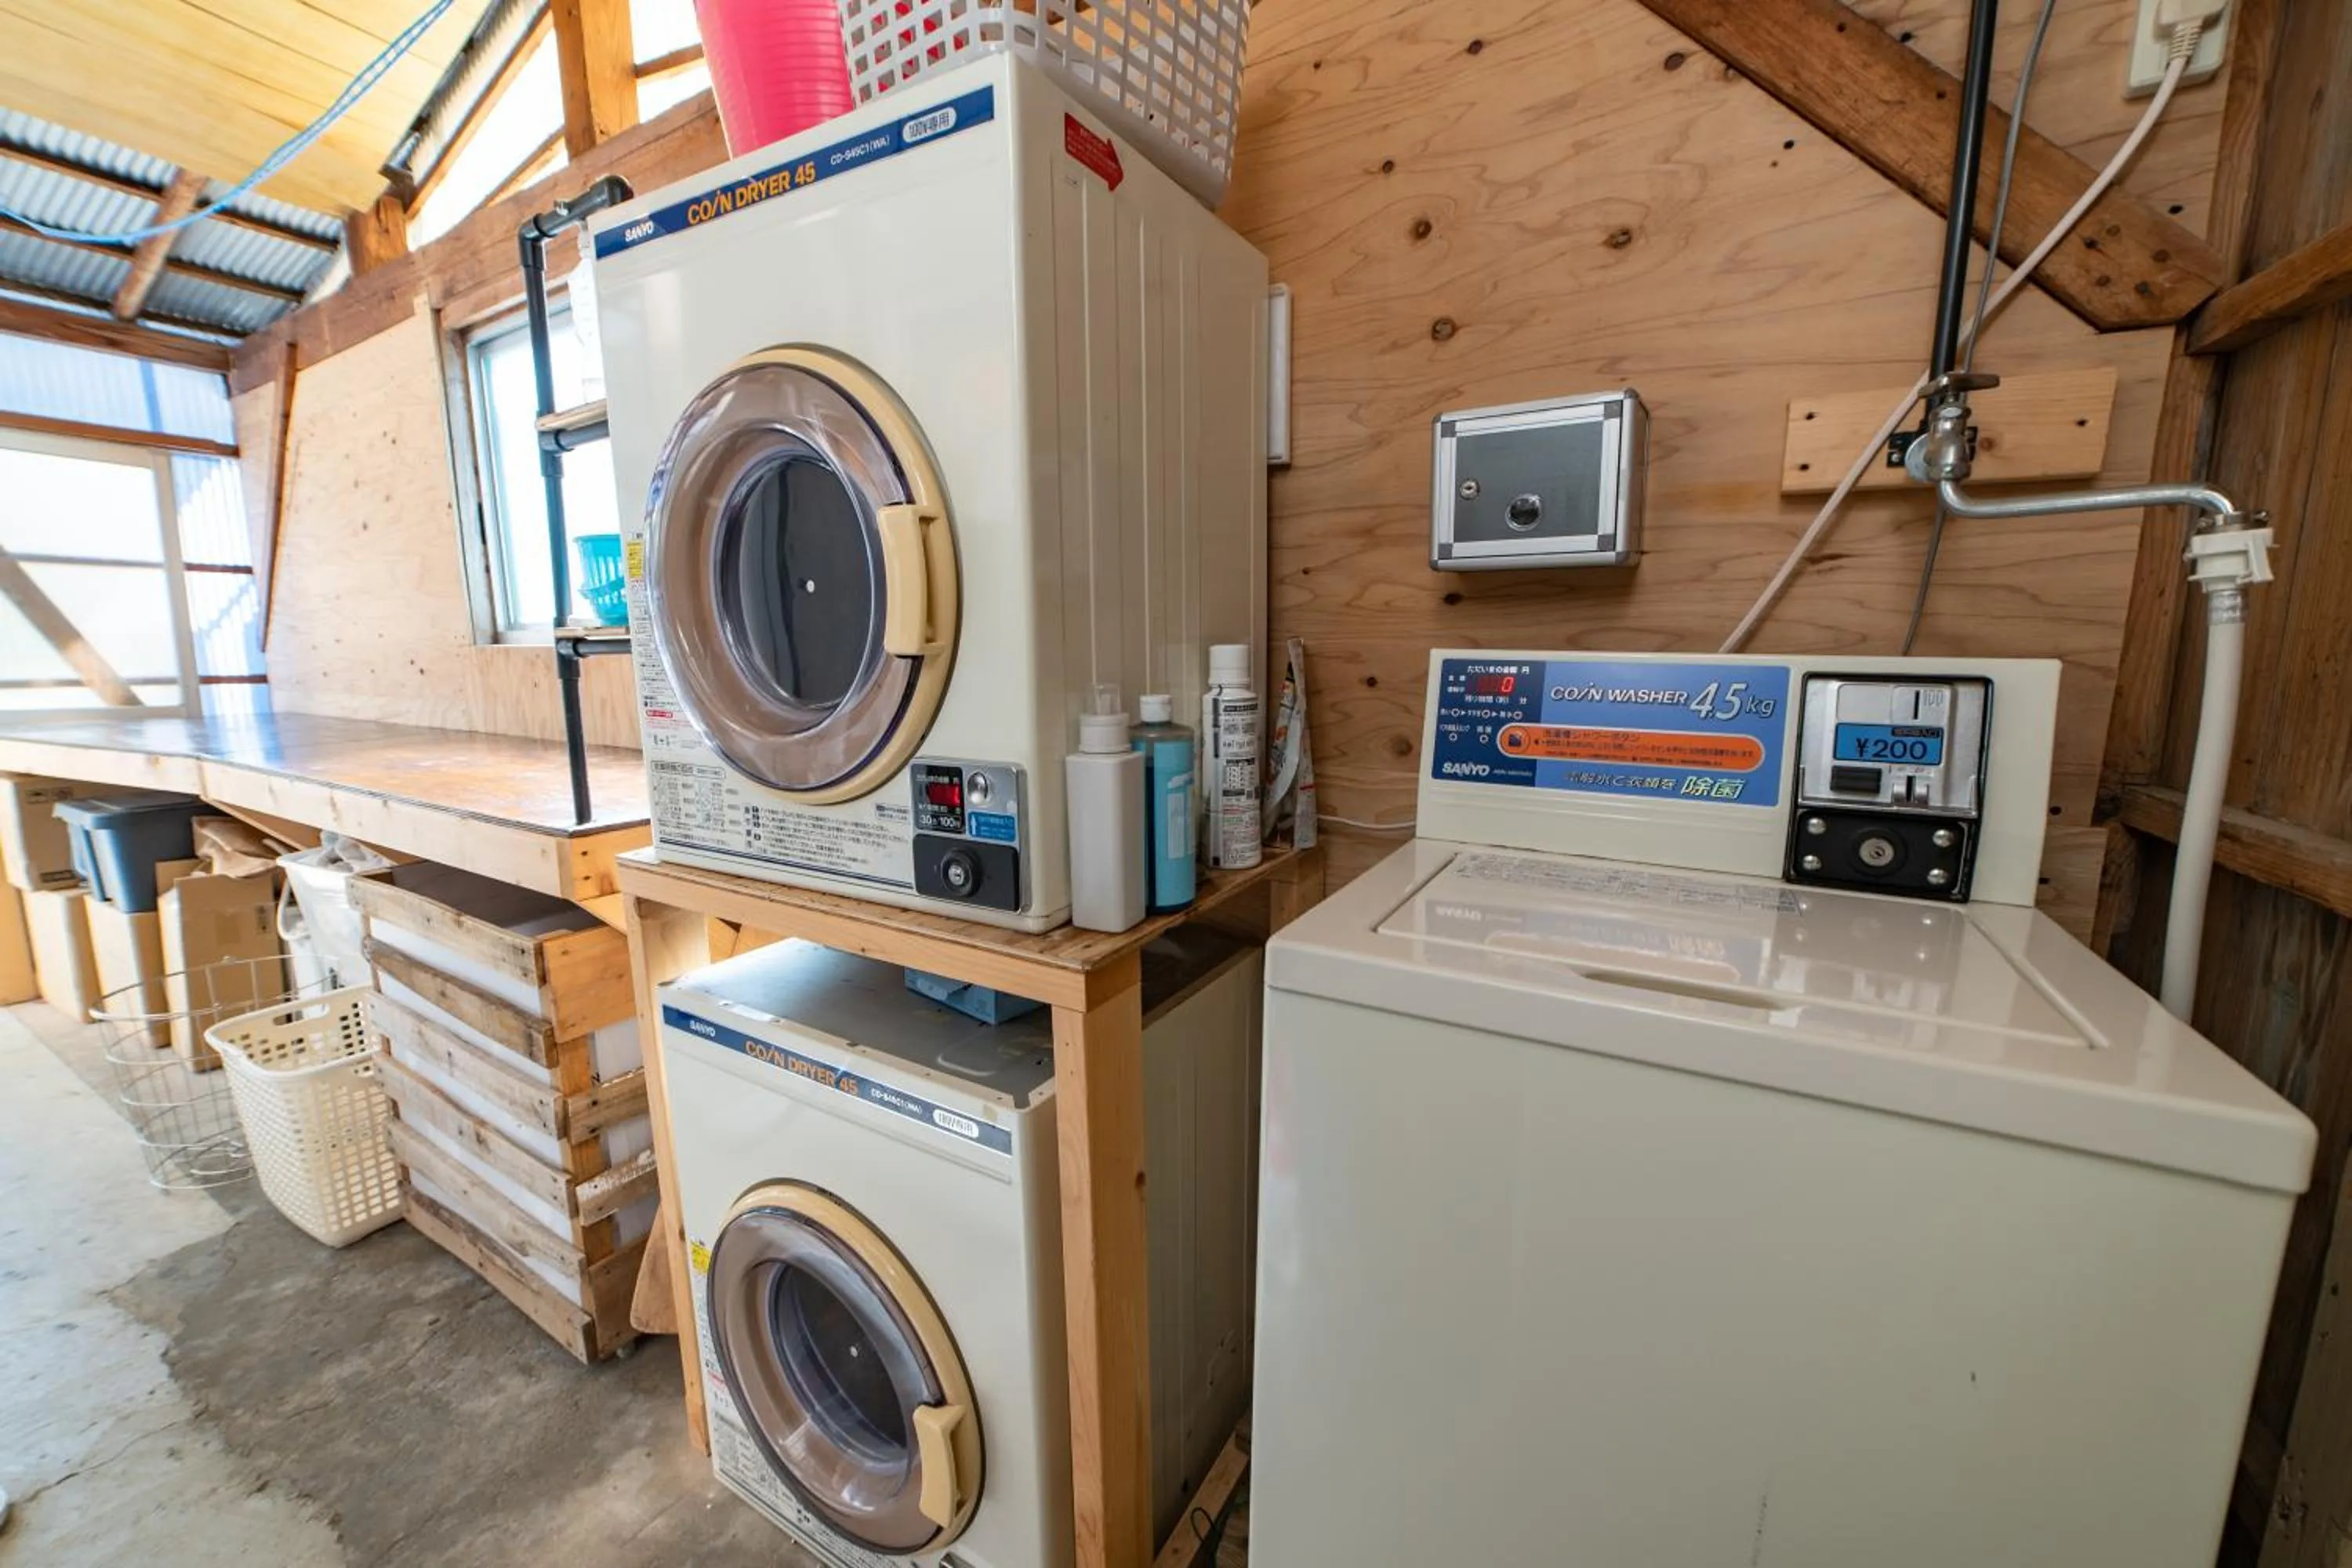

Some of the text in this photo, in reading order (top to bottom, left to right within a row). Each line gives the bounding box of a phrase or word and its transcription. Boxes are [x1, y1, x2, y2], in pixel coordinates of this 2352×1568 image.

[625, 220, 655, 242] SANYO
[688, 188, 732, 225] COIN
[735, 171, 790, 207] DRYER
[795, 162, 816, 185] 45
[1501, 677, 1514, 692] 0
[1551, 681, 1603, 701] COIN
[1608, 689, 1688, 703] WASHER
[1857, 738, 1928, 760] ¥200
[1443, 761, 1490, 776] SANYO
[746, 1041, 784, 1067] COIN
[788, 1057, 836, 1087] DRYER
[840, 1078, 858, 1095] 45
